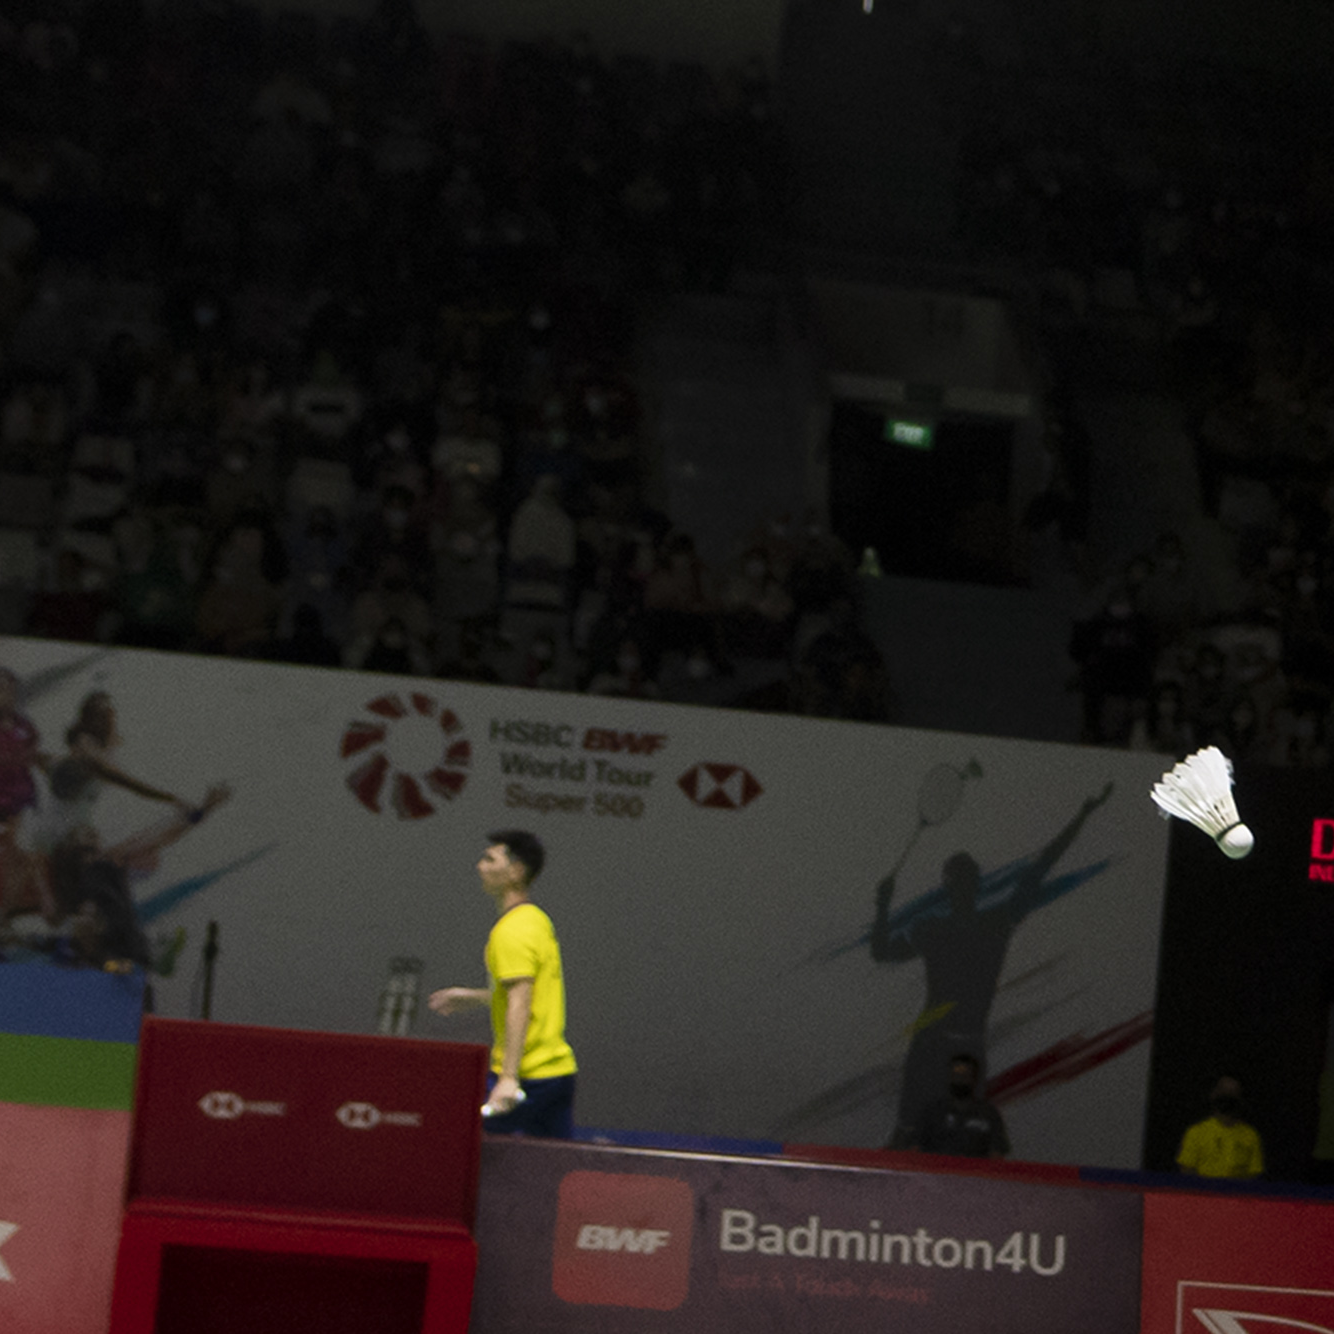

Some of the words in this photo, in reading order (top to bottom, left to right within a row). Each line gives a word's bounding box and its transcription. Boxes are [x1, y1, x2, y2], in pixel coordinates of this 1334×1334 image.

[489, 718, 572, 747] HSBC
[582, 727, 668, 755] BWF
[500, 752, 586, 782] World
[593, 758, 654, 787] Tour
[505, 783, 586, 815] Super
[593, 791, 645, 819] 500
[575, 1223, 672, 1256] BWF
[719, 1207, 1068, 1278] Badminton4U
